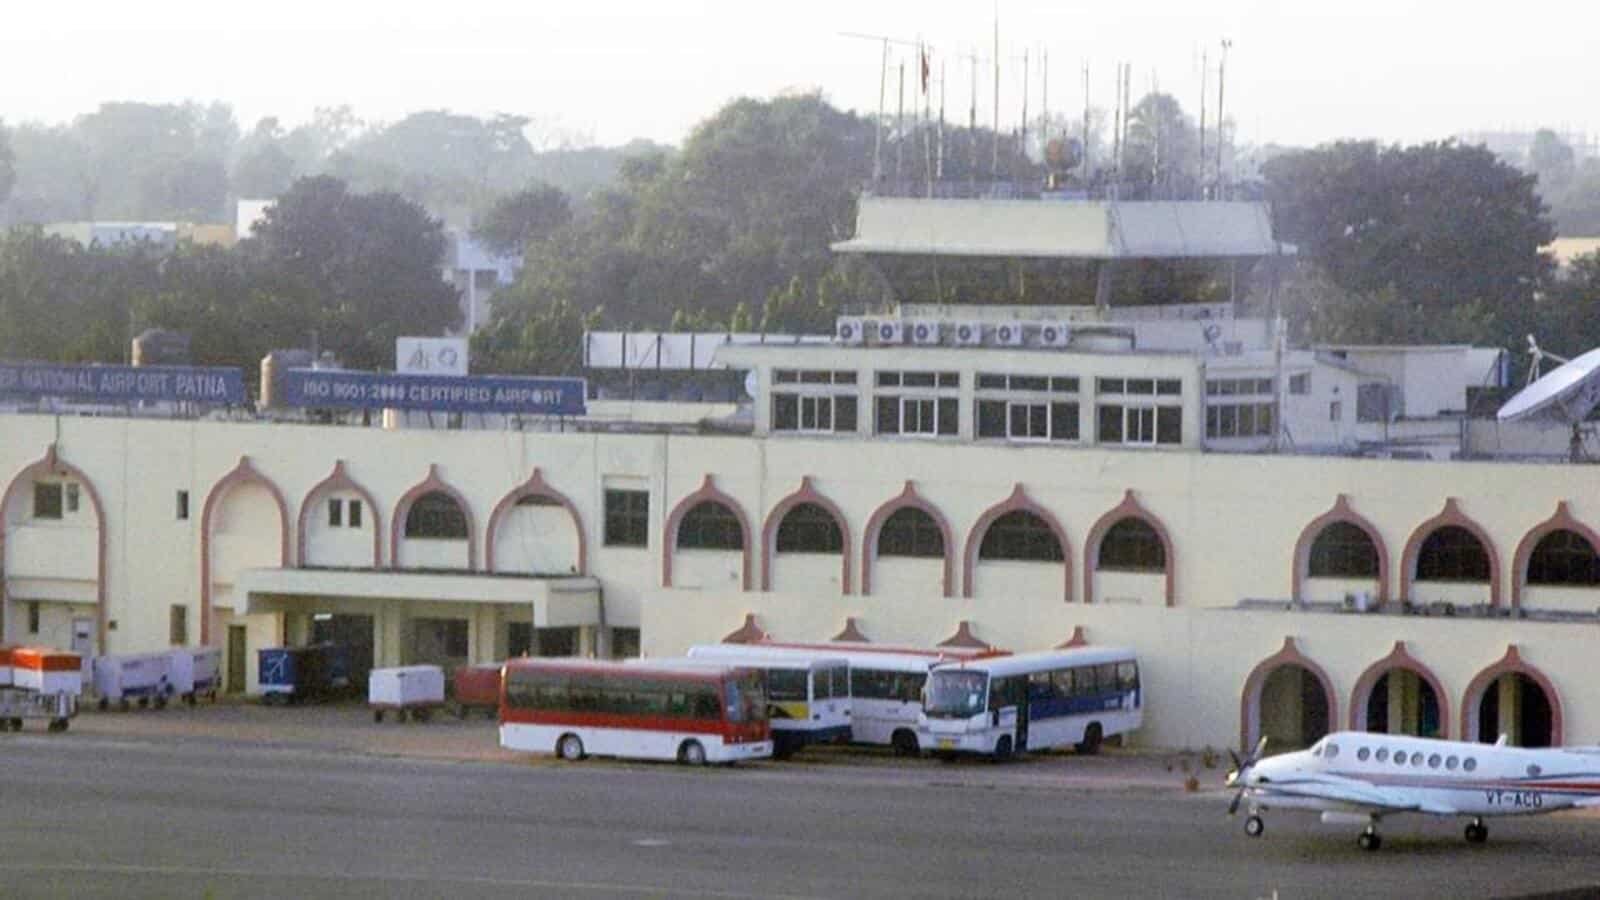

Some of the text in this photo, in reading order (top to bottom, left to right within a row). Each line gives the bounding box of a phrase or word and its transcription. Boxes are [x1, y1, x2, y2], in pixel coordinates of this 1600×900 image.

[100, 373, 169, 394] AIRPORT
[175, 373, 227, 397] PATNA
[303, 381, 330, 398] ISO
[409, 385, 490, 403] CERTIFIED
[495, 386, 563, 405] AIRPORT
